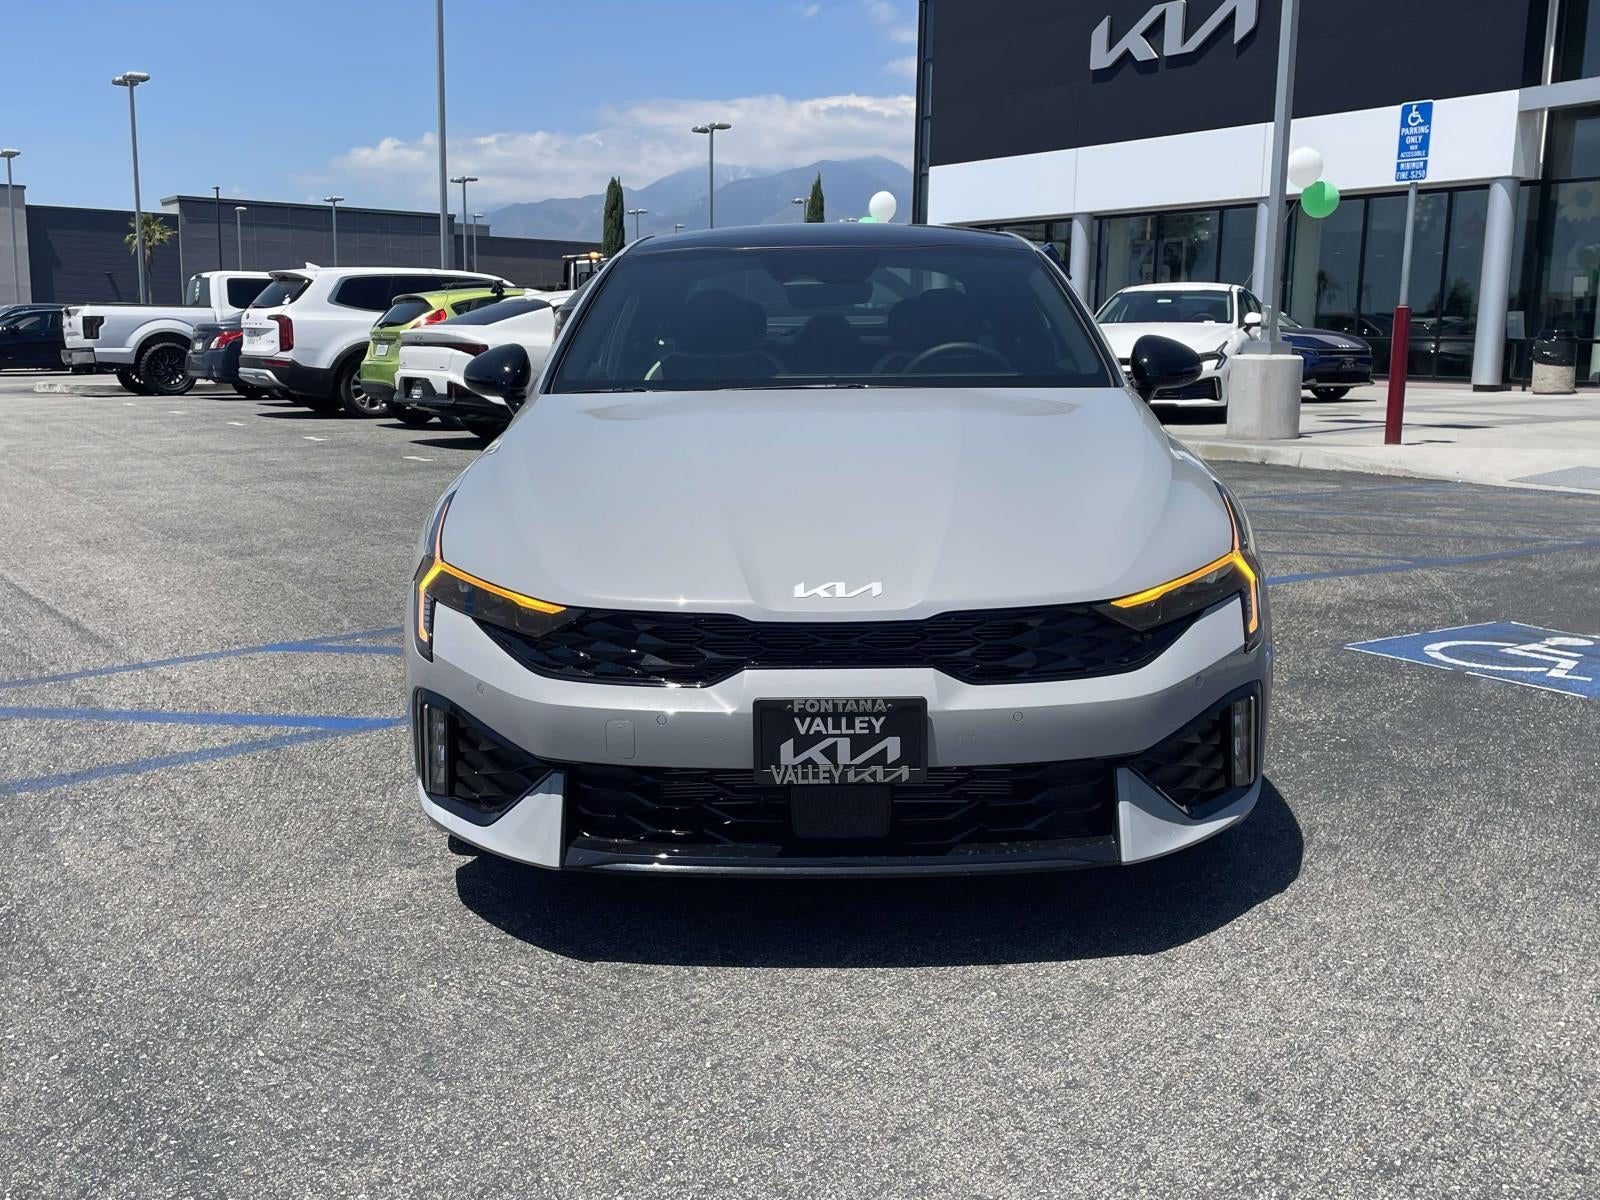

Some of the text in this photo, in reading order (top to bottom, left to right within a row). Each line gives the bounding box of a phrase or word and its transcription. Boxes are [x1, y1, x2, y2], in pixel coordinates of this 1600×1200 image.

[1089, 0, 1259, 70] KIA
[1401, 125, 1429, 136] PARKING
[1406, 135, 1423, 144] ONLY
[1400, 150, 1426, 158] ACCESSIBLE
[1400, 161, 1424, 170] MINIMUM
[1397, 170, 1426, 180] FINE $250
[794, 582, 882, 598] KIA
[793, 699, 887, 713] FONTANA
[794, 716, 886, 735] VALLEY
[780, 736, 901, 765] KIA
[770, 765, 910, 784] VALLEY KIA
